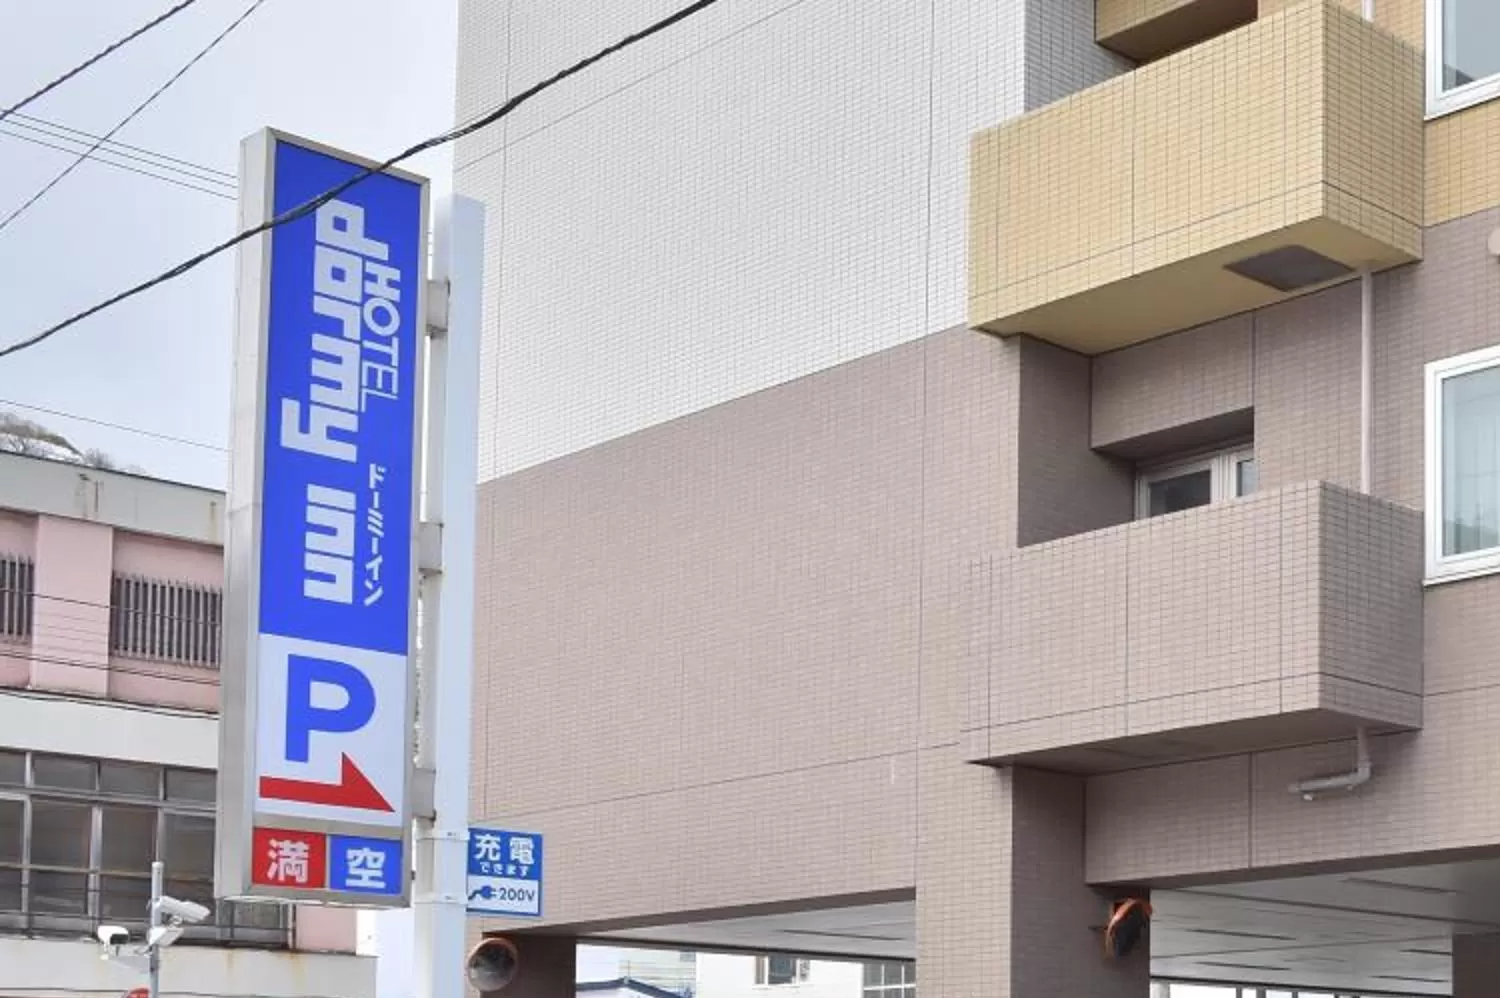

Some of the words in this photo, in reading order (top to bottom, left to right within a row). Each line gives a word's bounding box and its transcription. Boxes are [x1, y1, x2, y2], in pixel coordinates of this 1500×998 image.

[280, 199, 389, 463] dormy
[360, 258, 400, 413] HOTEL
[303, 483, 356, 605] inn
[363, 462, 388, 607] ドーミーイン
[284, 653, 377, 764] P
[266, 838, 311, 883] 満
[345, 847, 387, 889] 空
[474, 833, 535, 865] 充電
[499, 887, 535, 902] 200V
